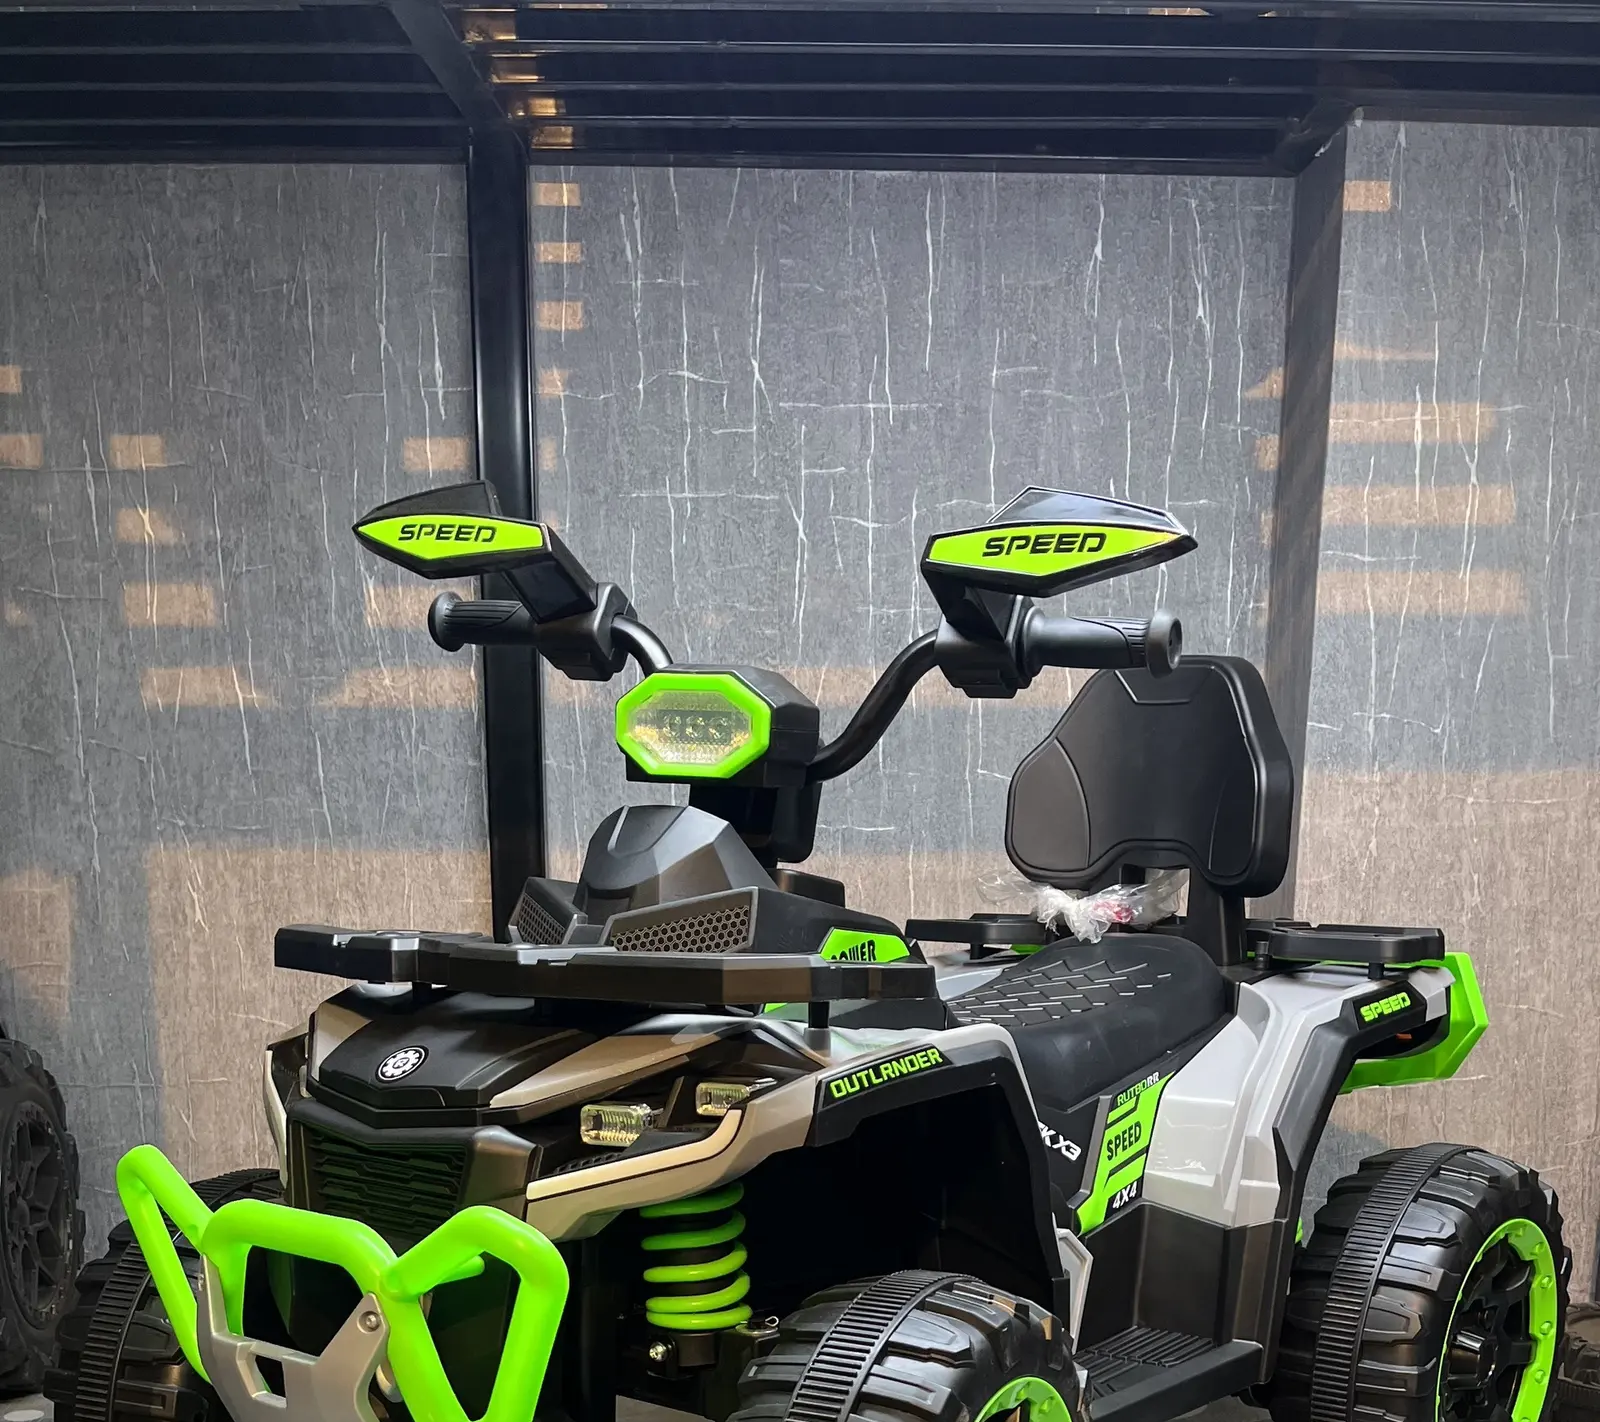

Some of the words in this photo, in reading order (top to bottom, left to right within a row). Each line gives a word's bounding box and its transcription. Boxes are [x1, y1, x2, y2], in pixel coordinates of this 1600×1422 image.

[399, 523, 497, 543] SPEED
[982, 532, 1107, 557] SPEED
[1360, 991, 1411, 1022] SPEED
[829, 1048, 943, 1099] OUTLANDER
[1106, 1120, 1142, 1161] SPEED
[1112, 1181, 1137, 1209] 4X4
